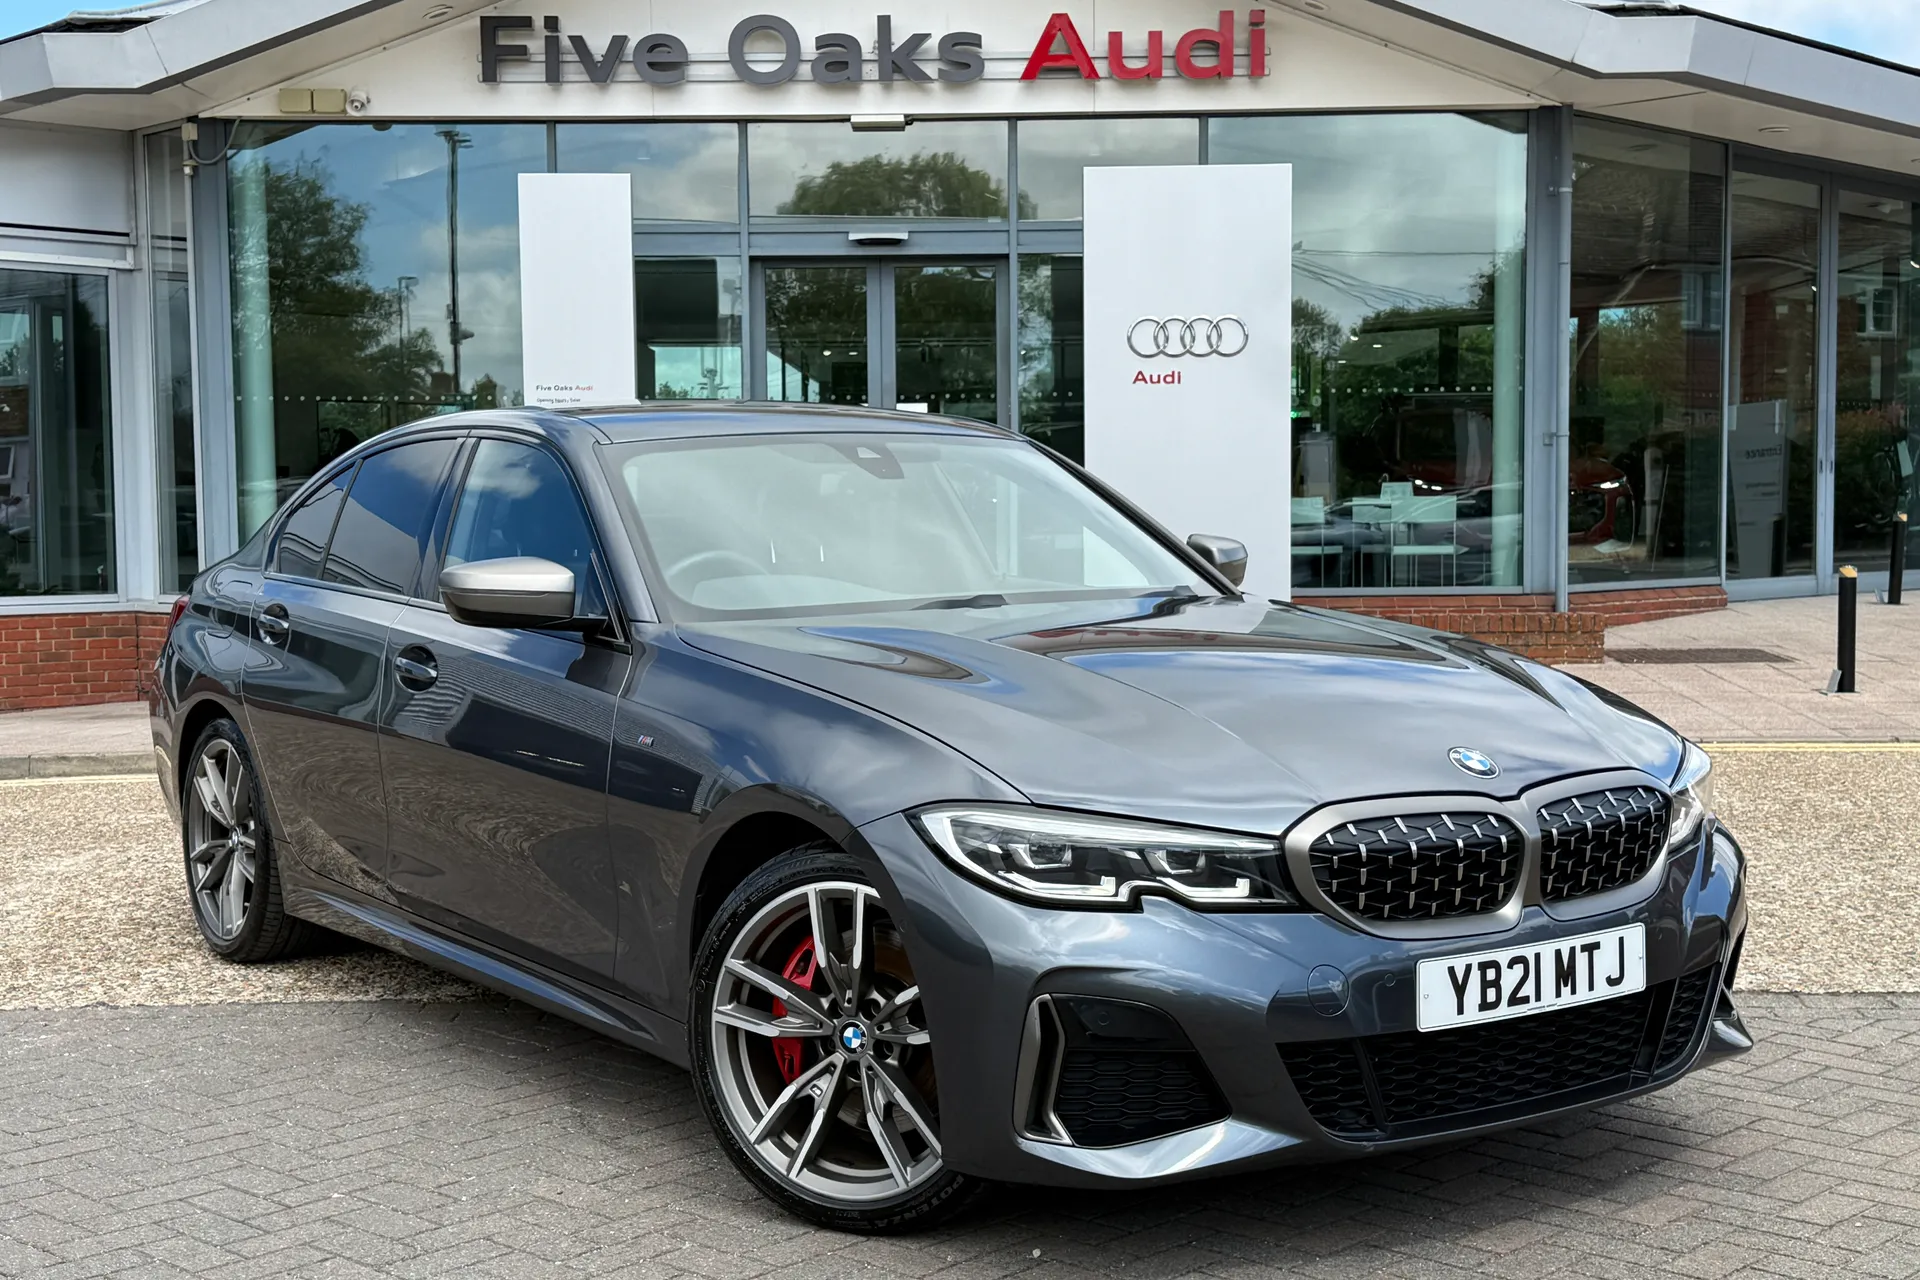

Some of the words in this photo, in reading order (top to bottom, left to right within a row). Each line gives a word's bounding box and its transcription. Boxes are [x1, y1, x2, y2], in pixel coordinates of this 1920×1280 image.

[480, 16, 688, 85] Five
[728, 14, 985, 85] Oaks
[1019, 10, 1266, 81] Audi
[1132, 370, 1182, 384] Audi
[1447, 952, 1542, 1016] YB21
[1555, 936, 1625, 999] MTJ
